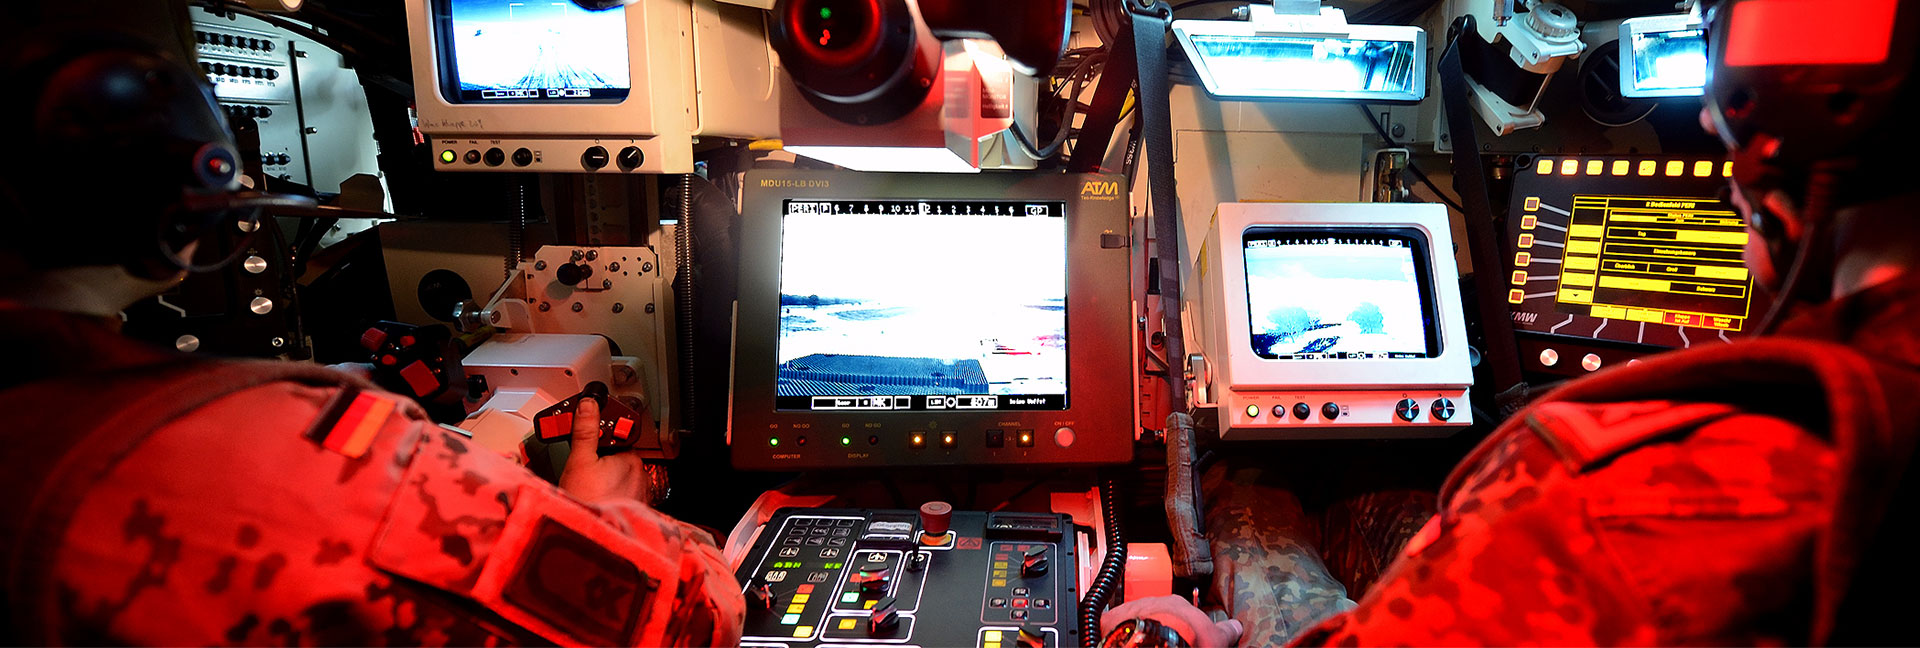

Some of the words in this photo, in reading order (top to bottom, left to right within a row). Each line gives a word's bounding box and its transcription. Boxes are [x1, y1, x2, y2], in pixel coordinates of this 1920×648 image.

[760, 179, 806, 187] MDU15-LB
[1081, 181, 1118, 195] ATM
[891, 204, 901, 212] 10
[905, 204, 915, 212] 11
